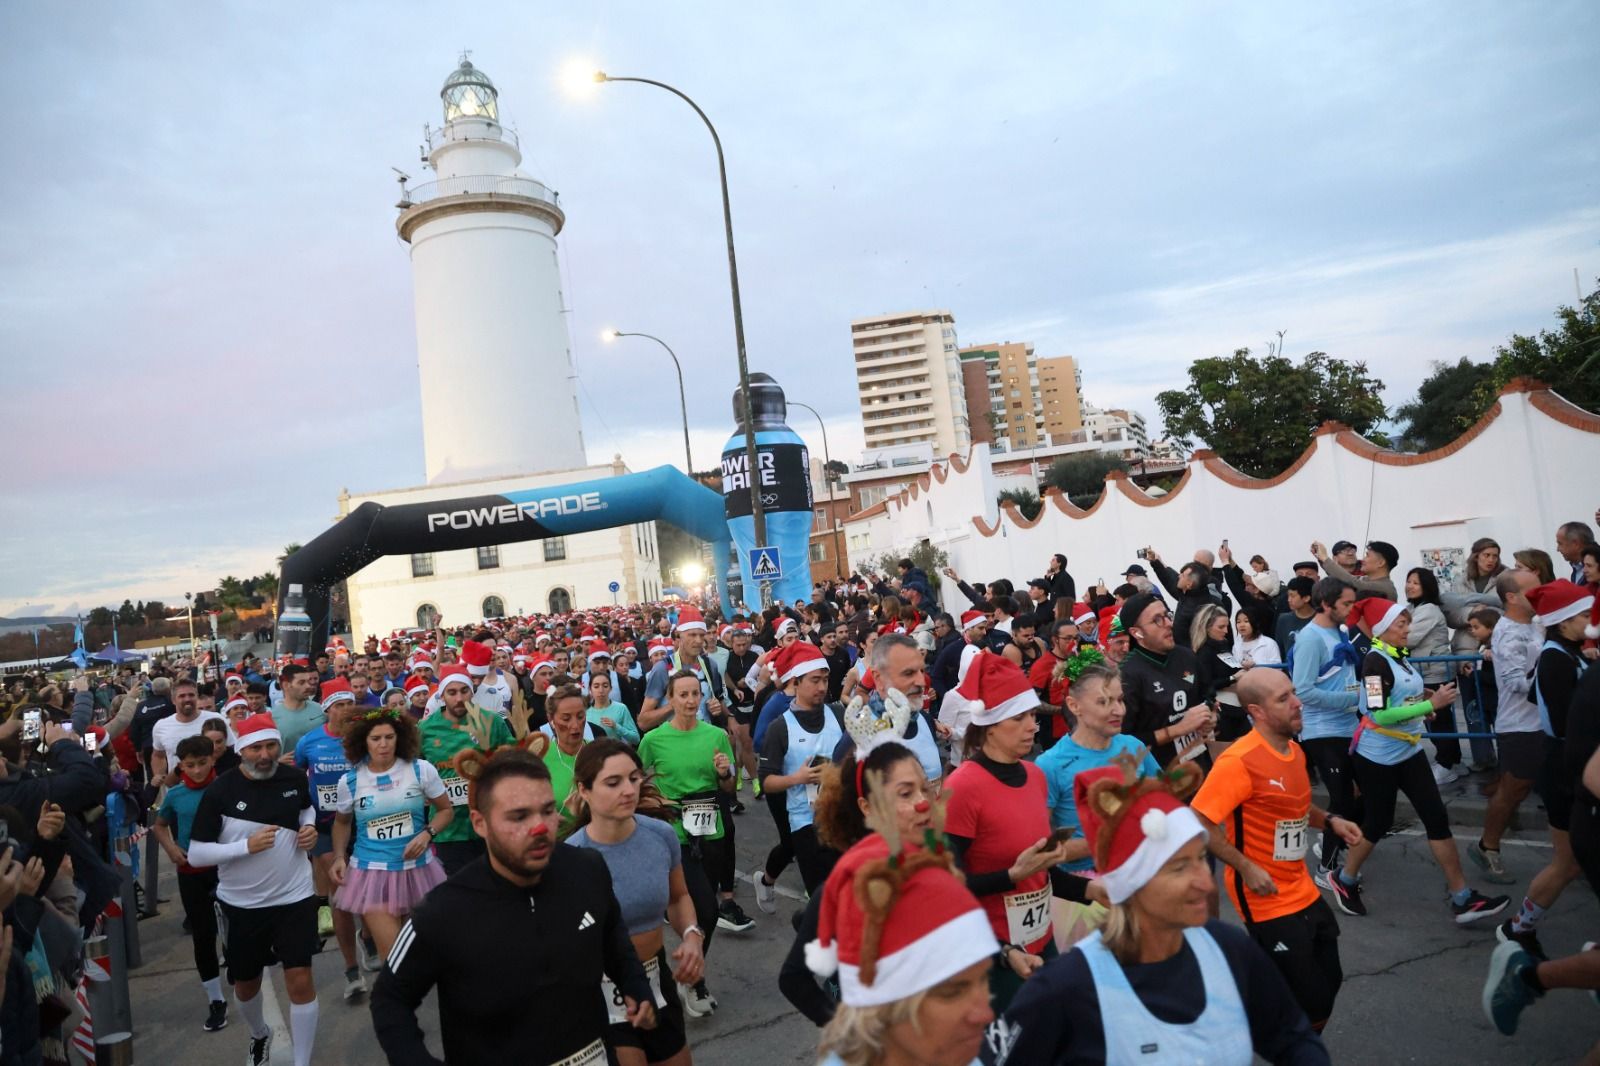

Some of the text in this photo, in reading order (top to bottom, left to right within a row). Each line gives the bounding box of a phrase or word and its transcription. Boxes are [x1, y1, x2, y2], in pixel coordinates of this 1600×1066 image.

[427, 491, 601, 533] POWERADE
[692, 812, 712, 826] 781
[376, 822, 403, 840] 677
